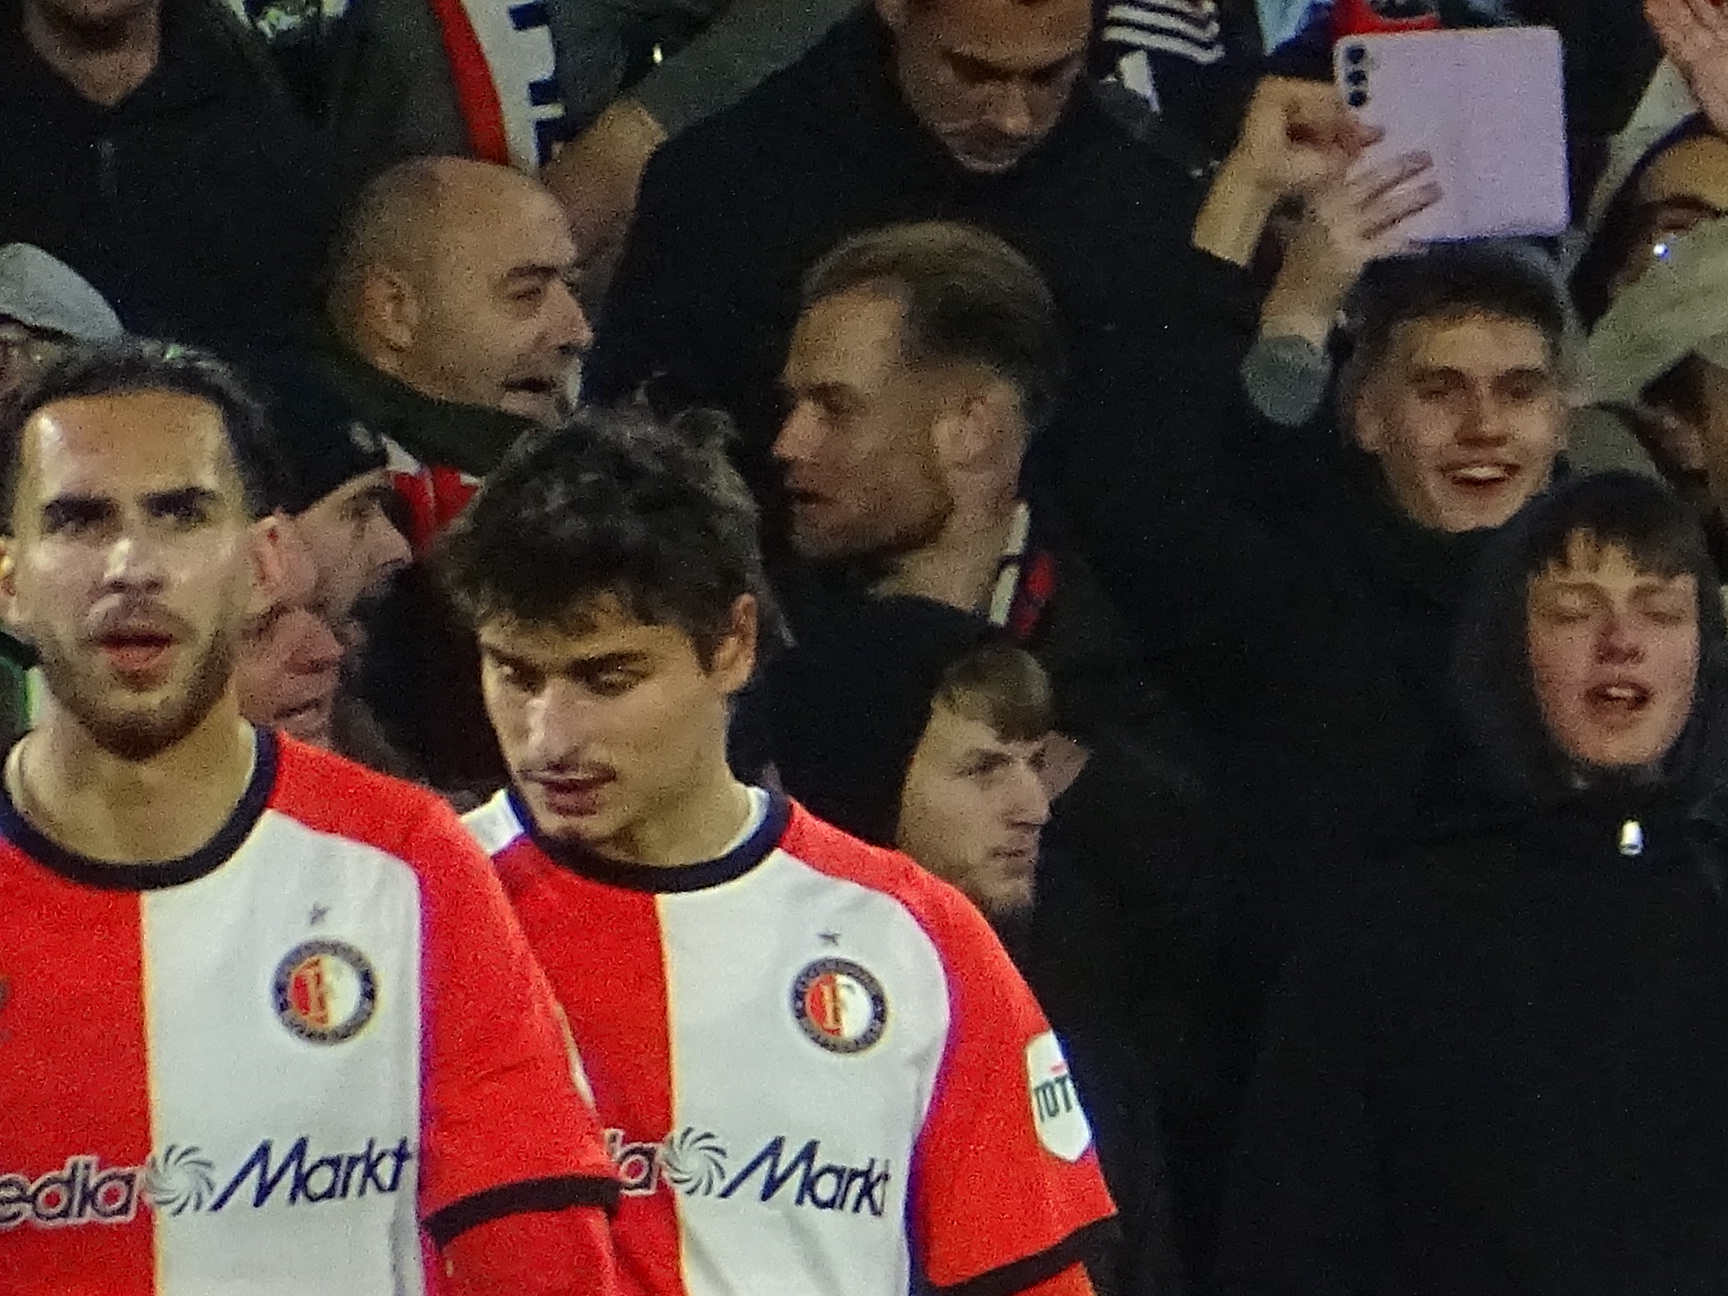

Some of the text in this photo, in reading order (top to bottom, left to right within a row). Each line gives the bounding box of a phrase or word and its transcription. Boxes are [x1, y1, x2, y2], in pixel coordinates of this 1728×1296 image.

[1034, 1074, 1072, 1122] TOT
[0, 1136, 411, 1228] edia Markt
[718, 1136, 892, 1216] Markt
